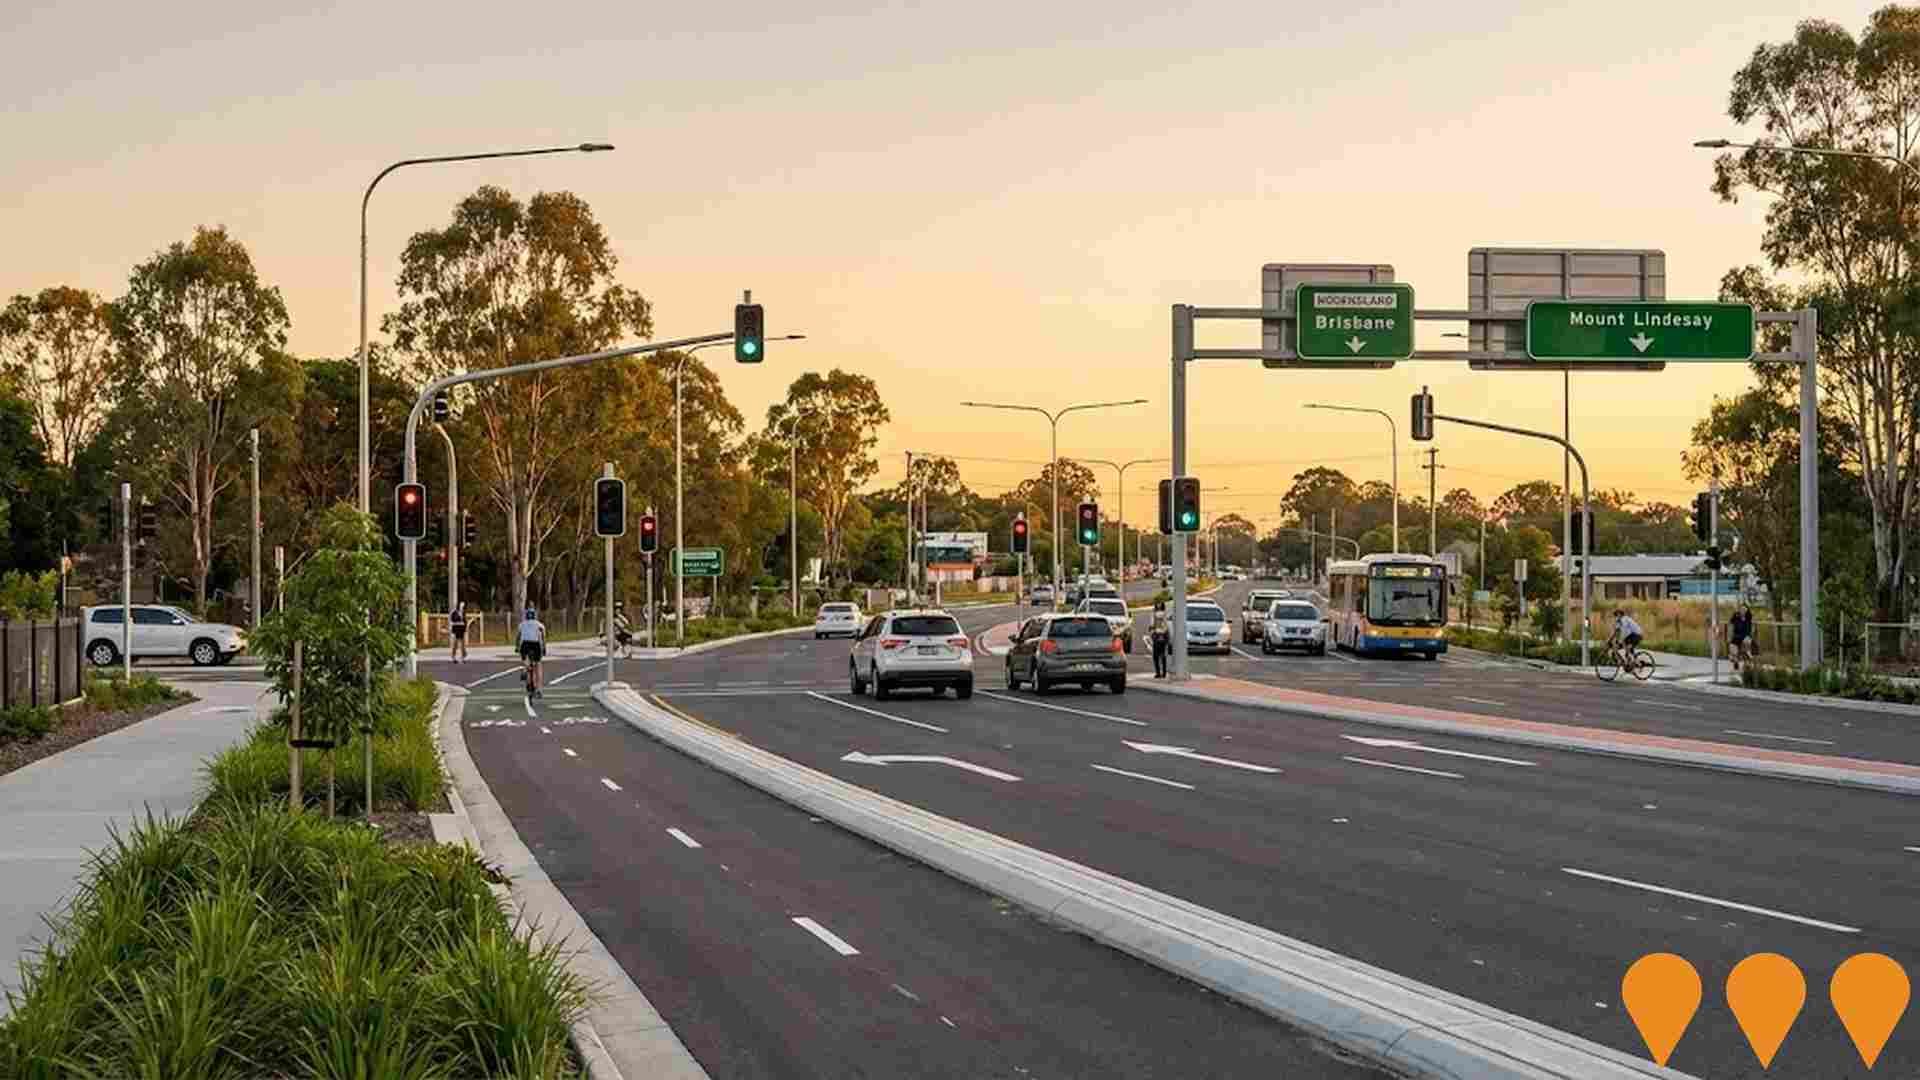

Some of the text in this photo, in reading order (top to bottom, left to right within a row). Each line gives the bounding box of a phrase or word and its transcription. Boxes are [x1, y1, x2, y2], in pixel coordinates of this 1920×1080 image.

[1315, 316, 1395, 331] Brisbane
[1570, 311, 1713, 330] Mount Lindesay
